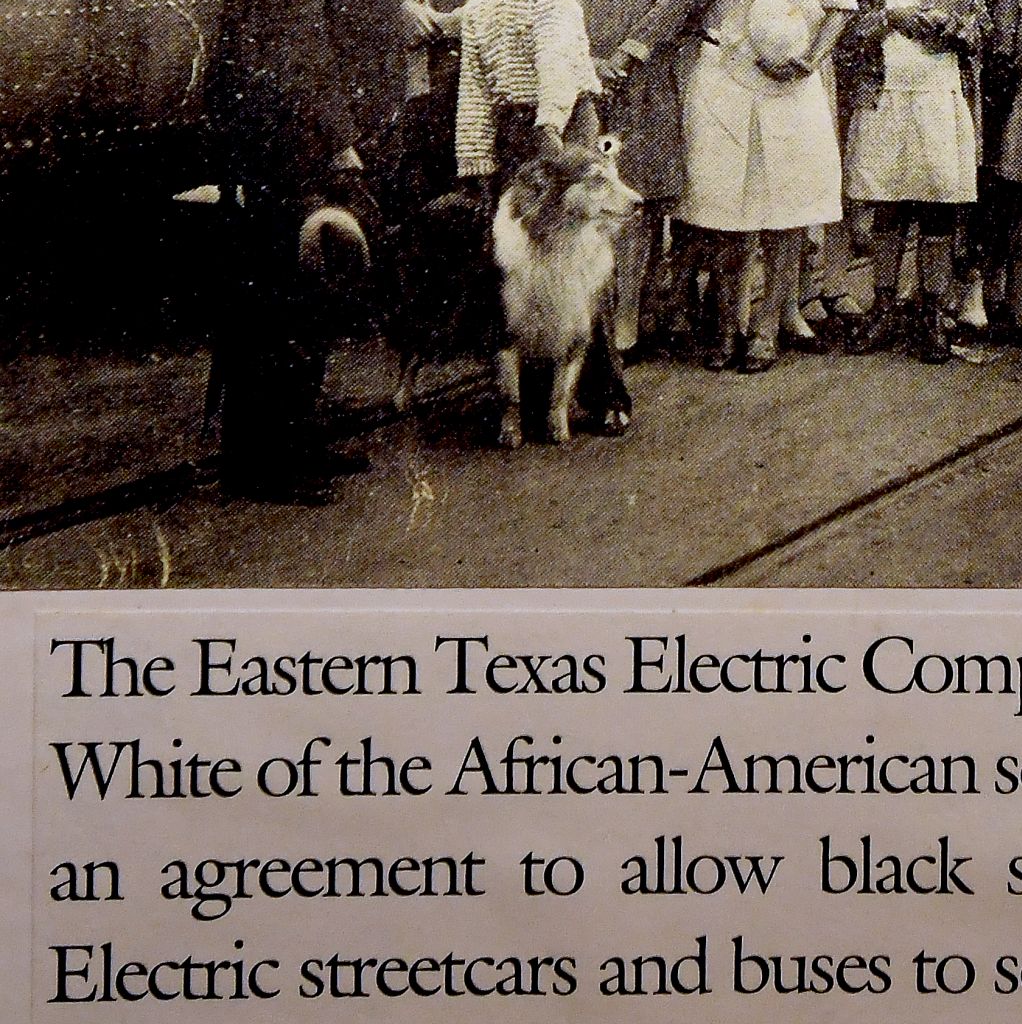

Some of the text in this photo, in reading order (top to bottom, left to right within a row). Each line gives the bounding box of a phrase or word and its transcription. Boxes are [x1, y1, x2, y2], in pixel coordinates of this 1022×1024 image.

[49, 636, 176, 698] The
[189, 638, 423, 697] Eastern
[434, 634, 607, 695] Texas
[622, 633, 847, 694] Electric
[47, 737, 243, 802] White
[256, 736, 332, 798] of
[334, 735, 433, 797] the
[444, 734, 982, 796] African-American
[49, 860, 126, 902] an
[160, 850, 487, 922] agreement
[519, 850, 585, 897] to
[620, 834, 786, 896] allow
[818, 833, 976, 896] black
[45, 938, 281, 1004] Electric
[298, 951, 578, 999] streetcars
[599, 933, 713, 997] and
[730, 934, 892, 995] buses
[911, 948, 976, 995] to
